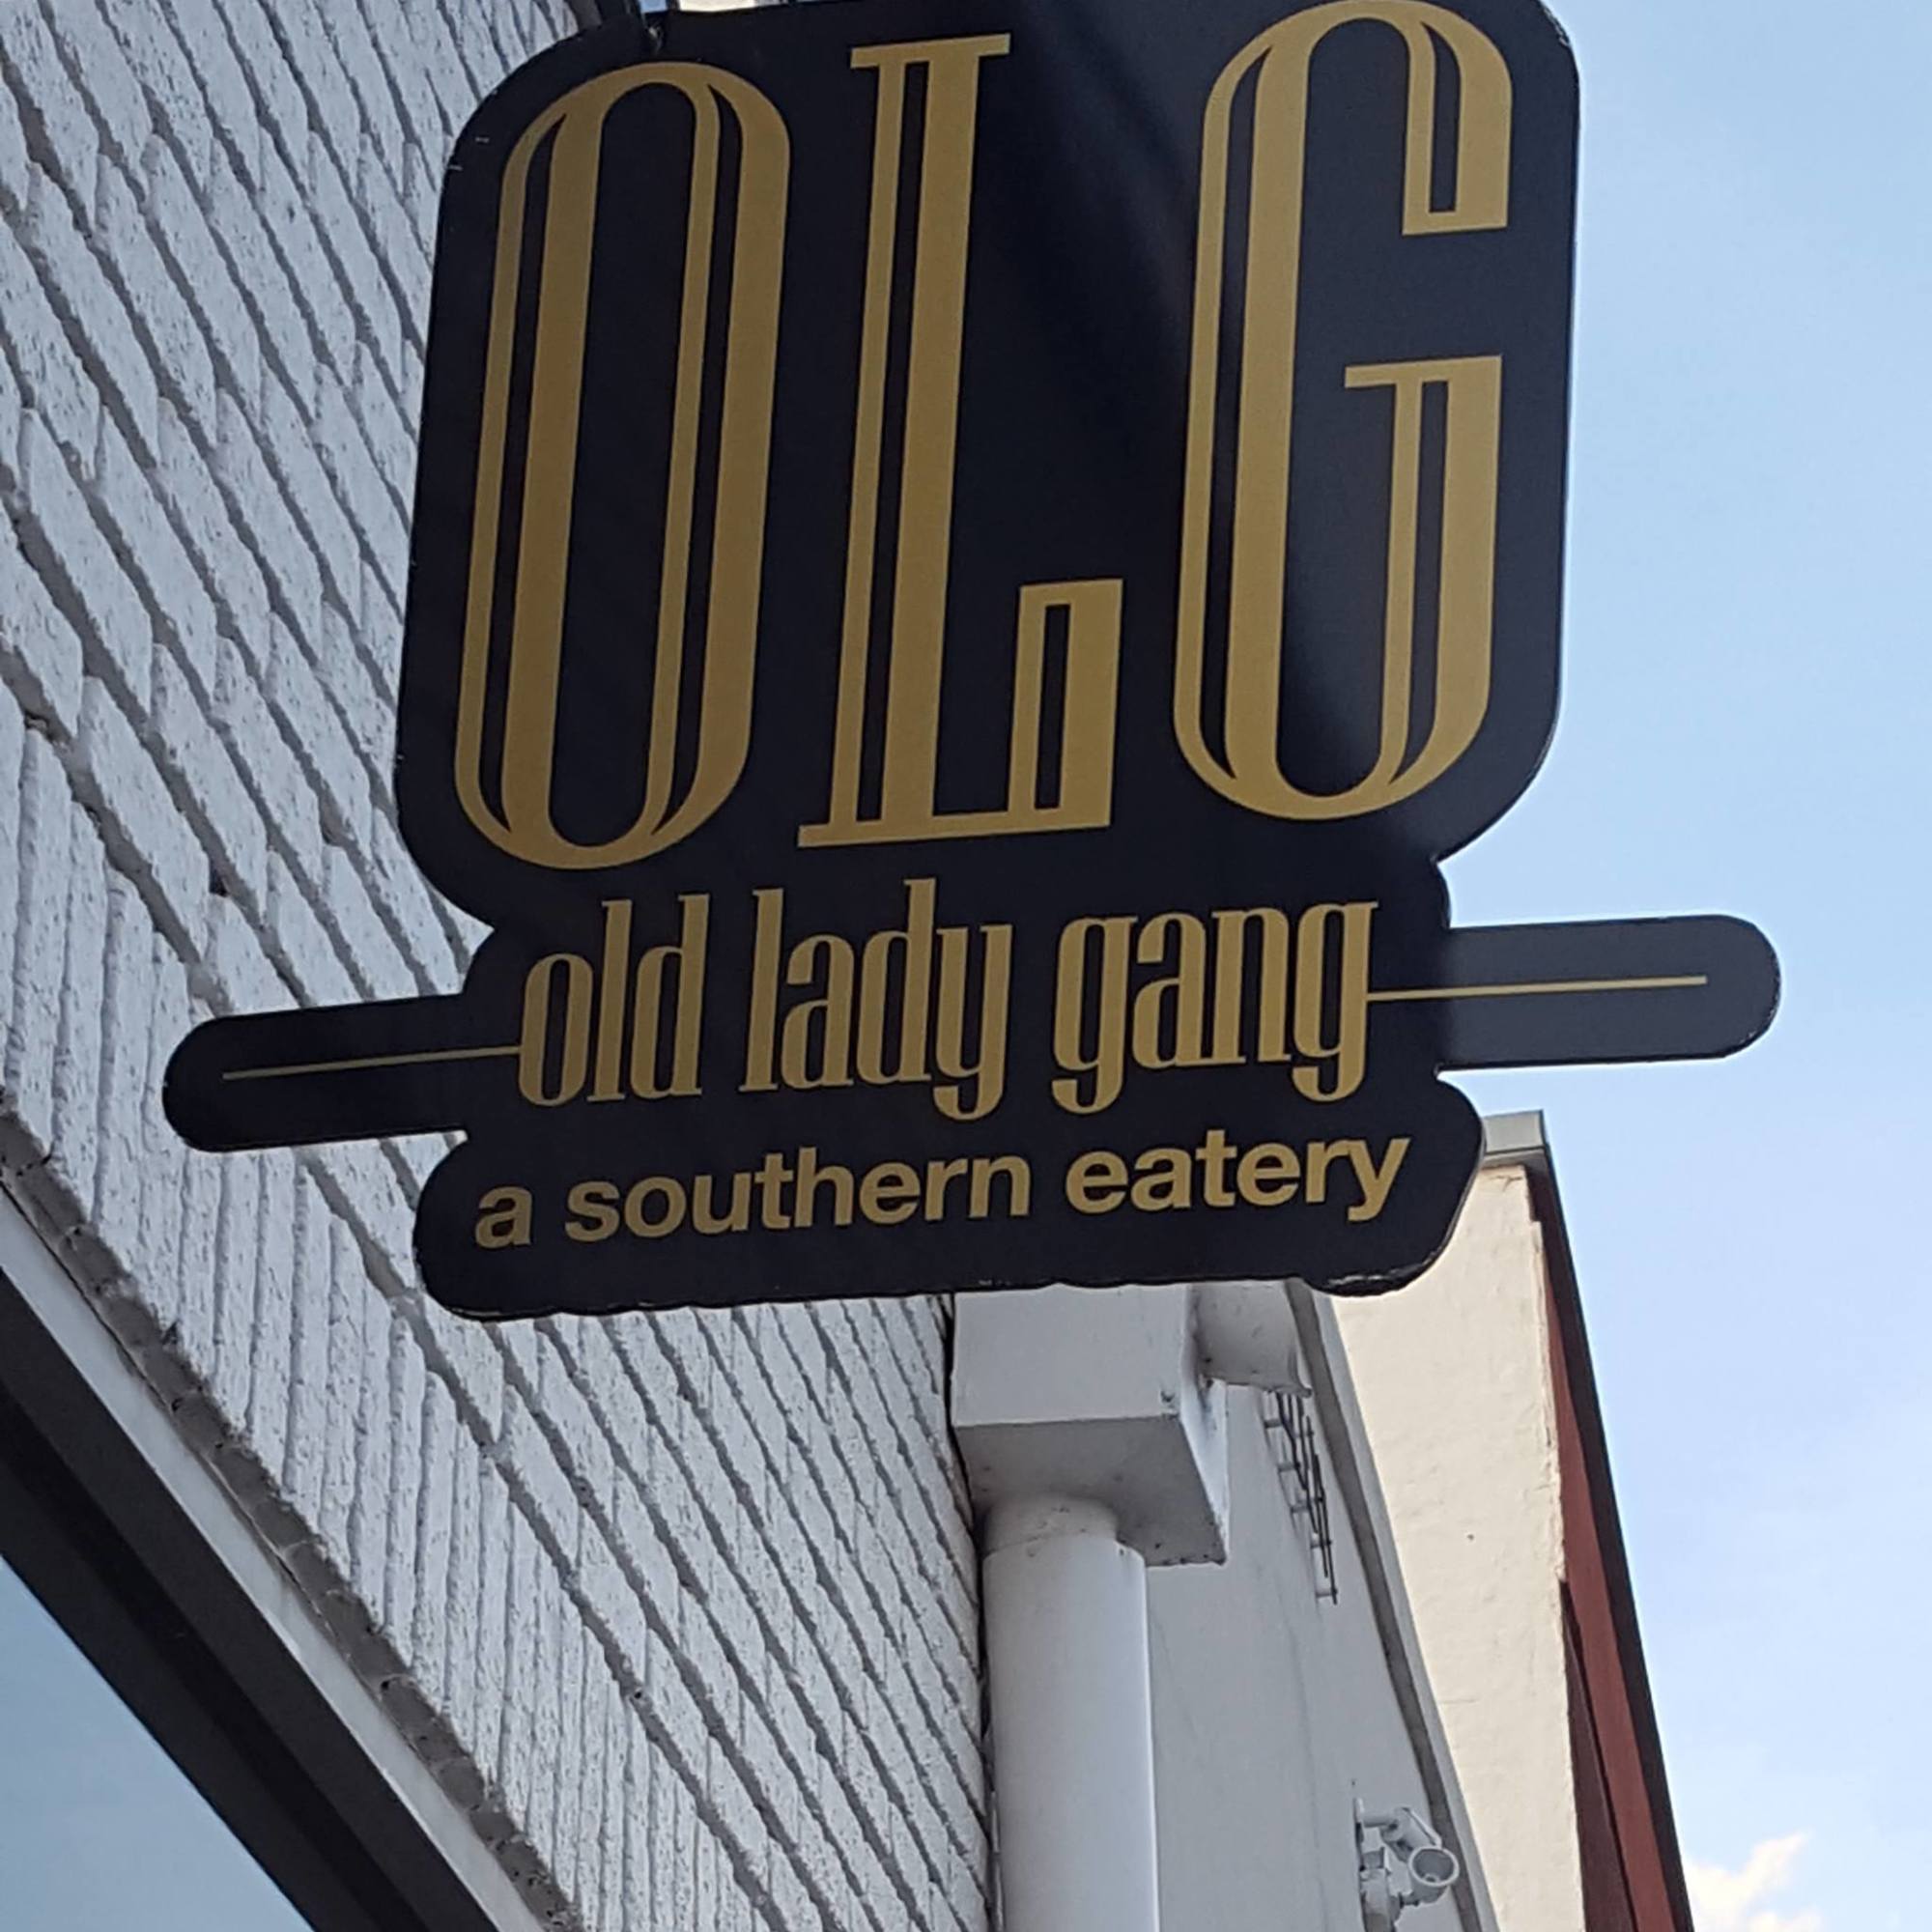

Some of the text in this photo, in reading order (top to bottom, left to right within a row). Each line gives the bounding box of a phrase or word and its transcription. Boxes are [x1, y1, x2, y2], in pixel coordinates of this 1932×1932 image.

[454, 0, 1513, 869] OLG
[519, 877, 1378, 1121] old lady gang
[474, 1129, 1411, 1249] a southern eatery
